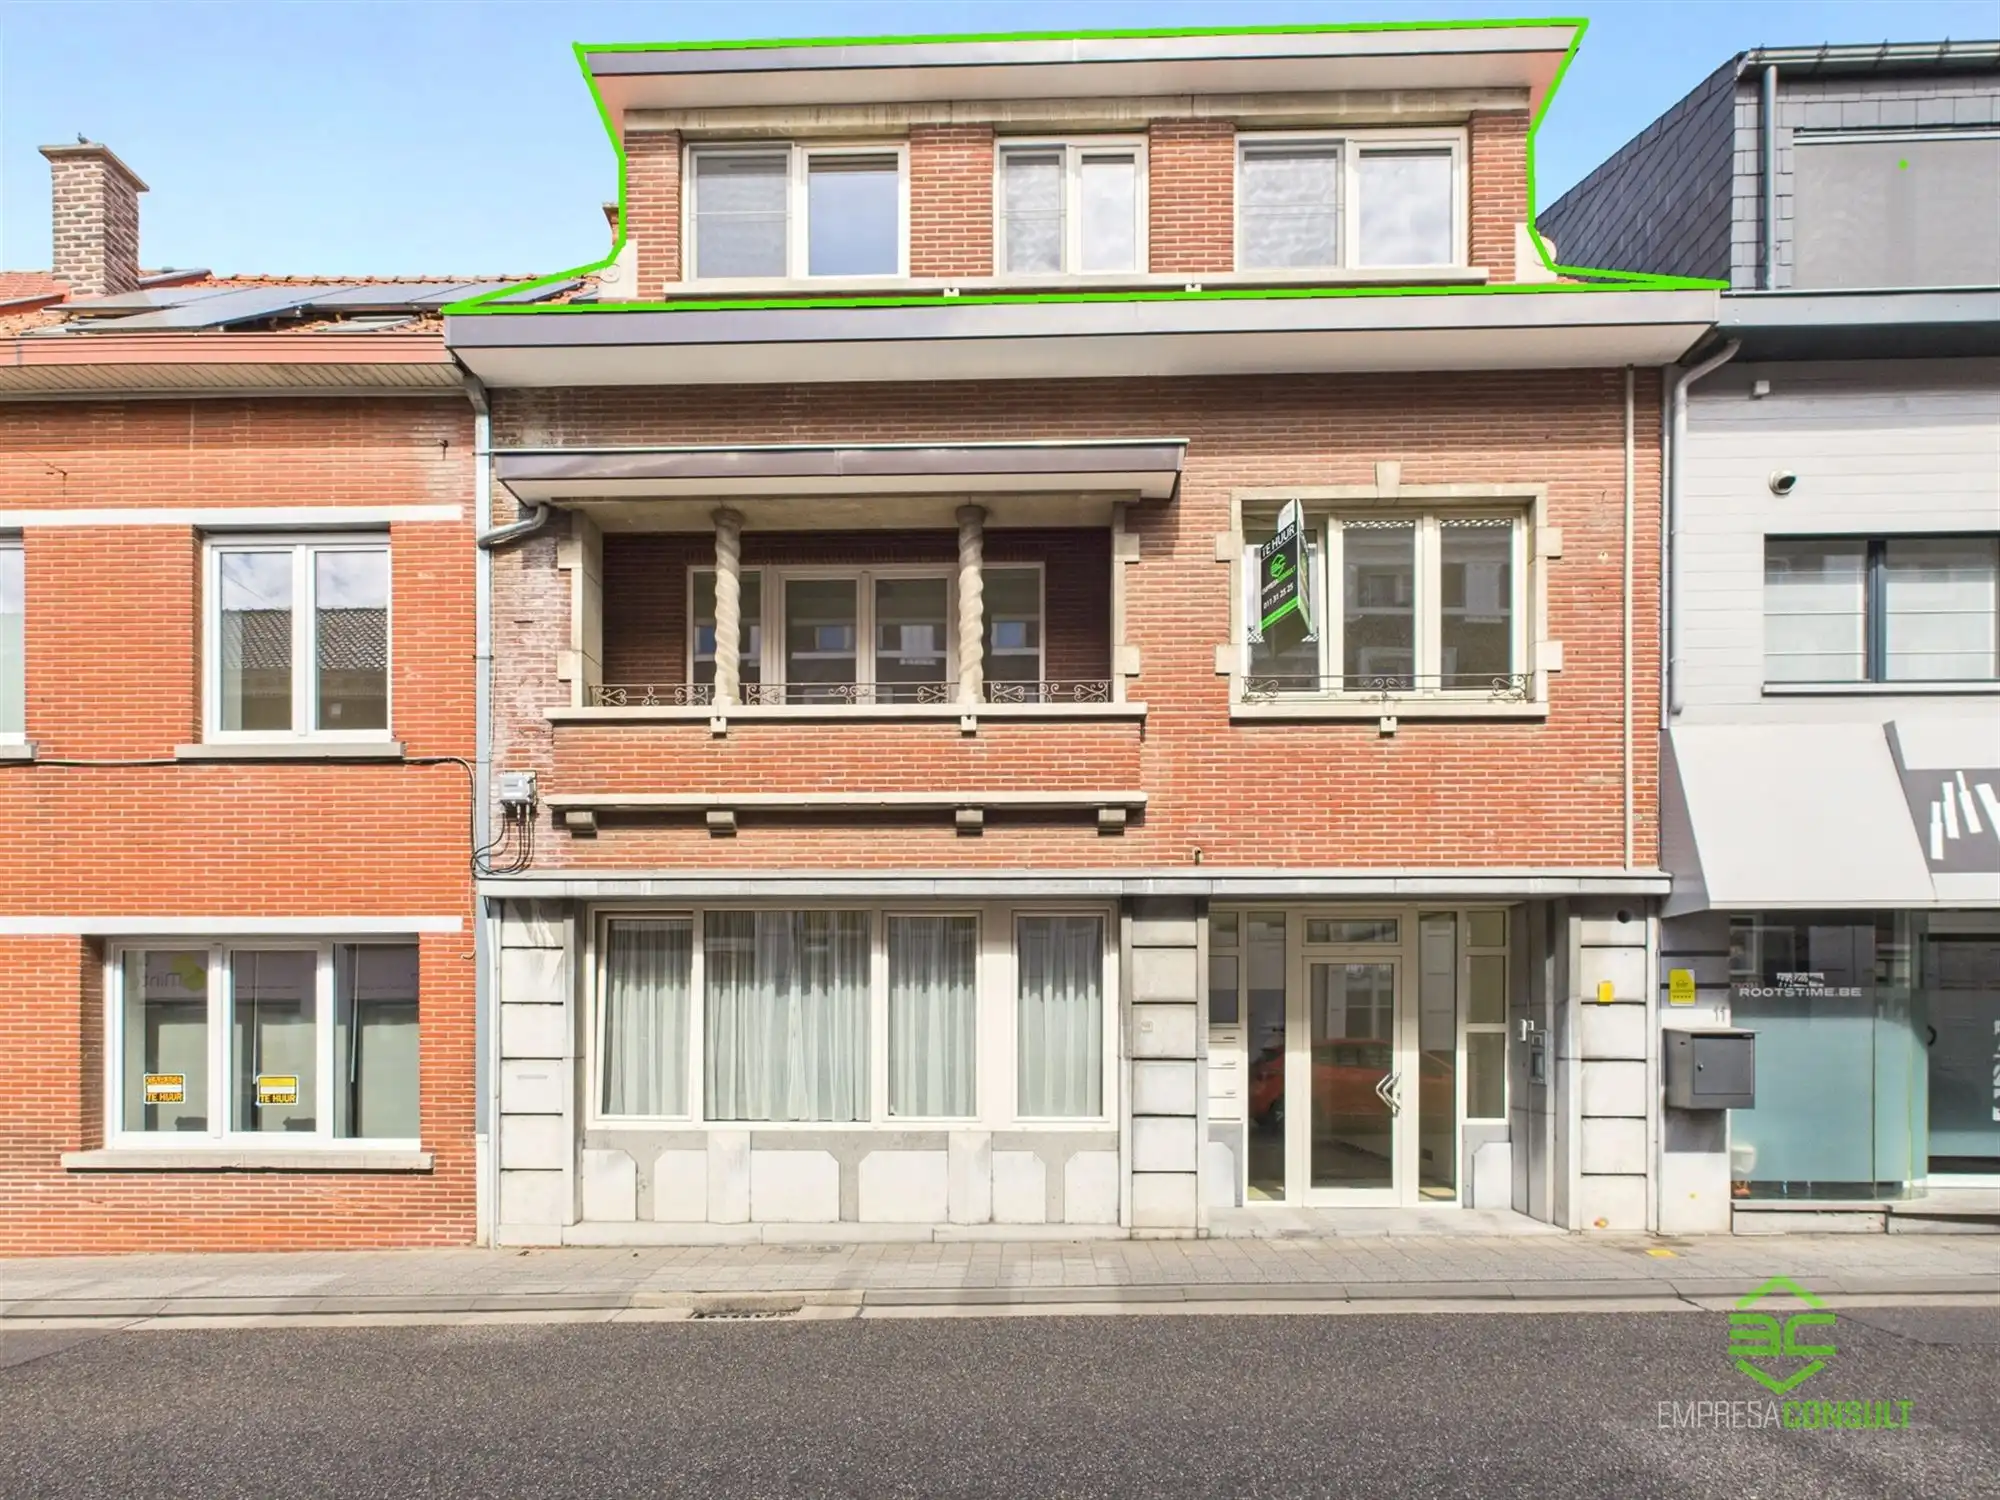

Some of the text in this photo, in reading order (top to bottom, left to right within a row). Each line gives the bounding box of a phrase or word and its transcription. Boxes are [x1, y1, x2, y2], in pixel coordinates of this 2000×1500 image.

[1262, 542, 1271, 557] TE
[1271, 524, 1295, 549] HUUR
[1739, 987, 1862, 997] ROOTSTIME.BE
[147, 1092, 182, 1102] TE HUUR
[260, 1094, 296, 1103] TE HUUR
